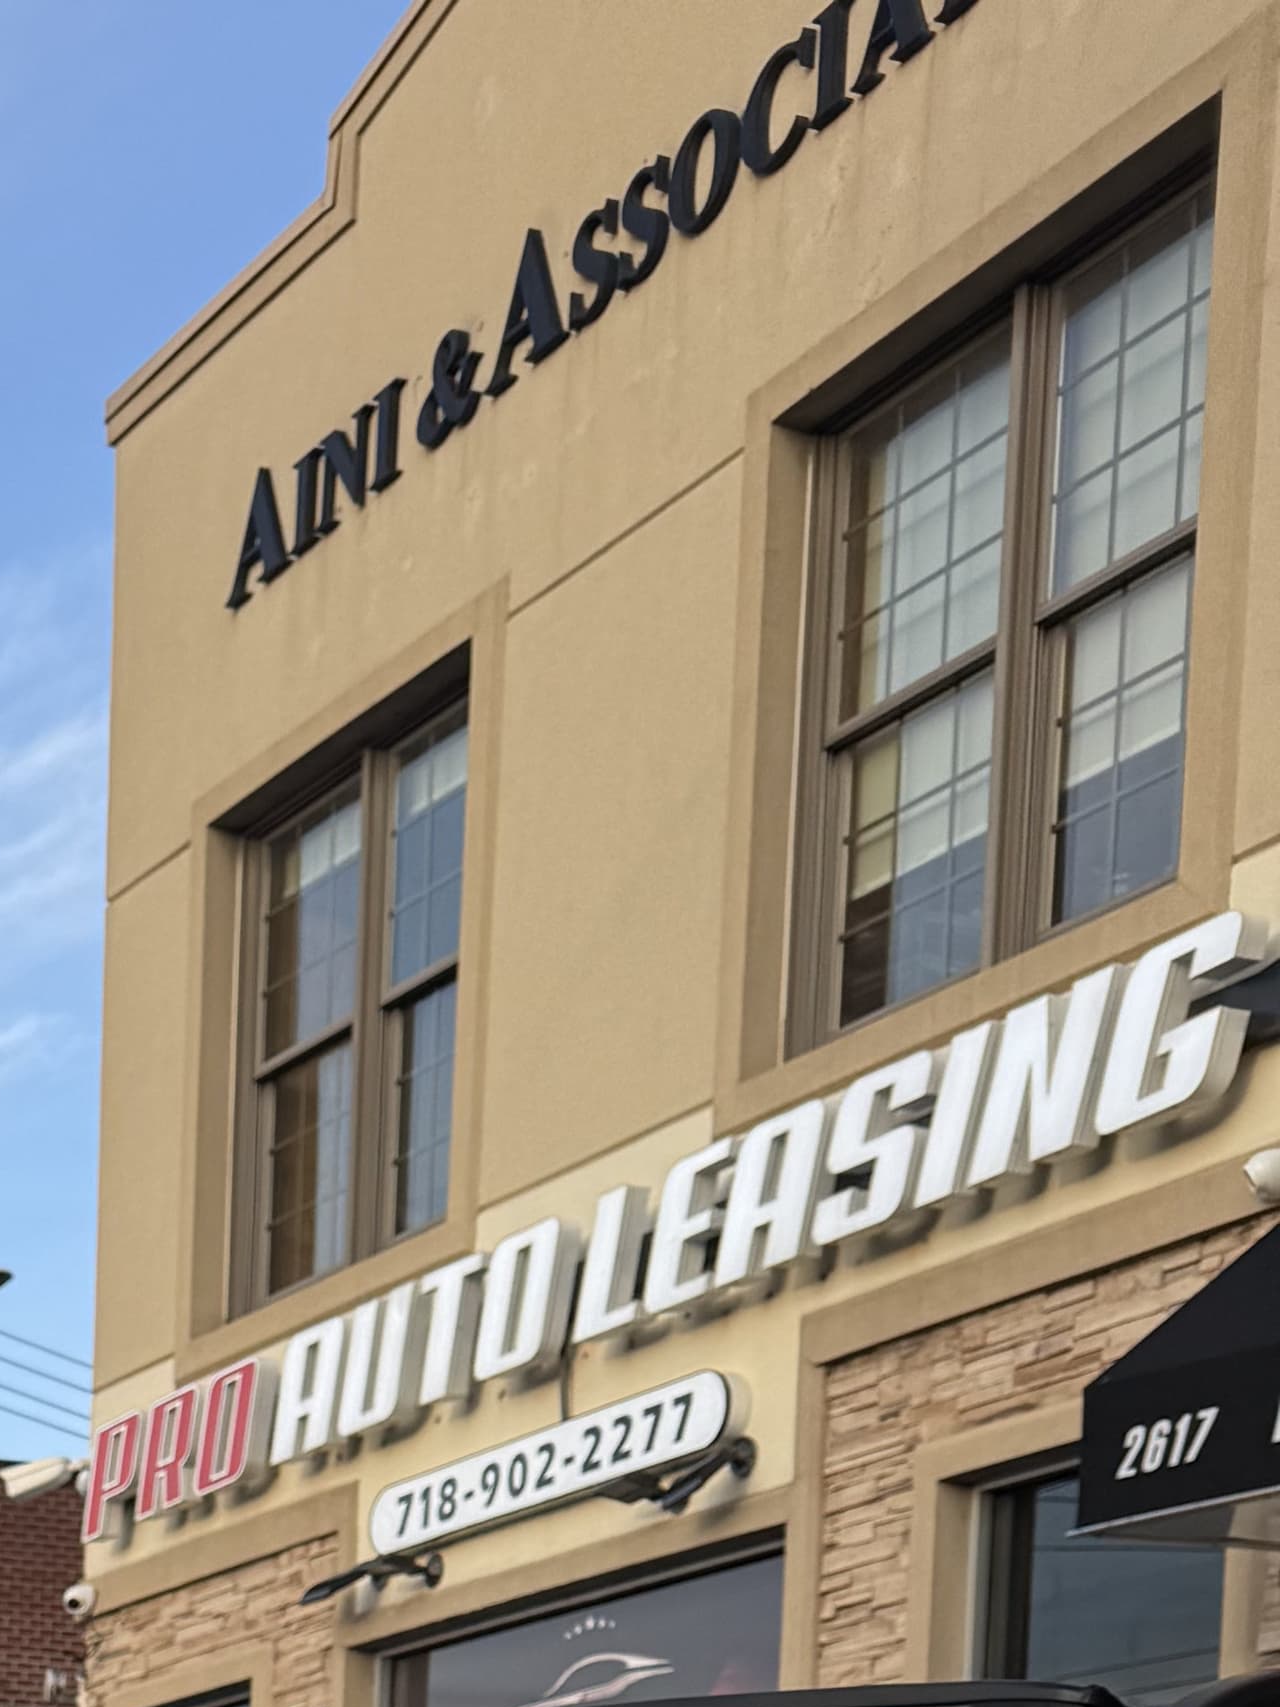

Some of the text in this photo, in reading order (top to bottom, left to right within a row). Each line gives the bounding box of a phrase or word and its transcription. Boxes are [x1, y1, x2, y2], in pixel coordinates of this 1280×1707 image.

[226, 0, 984, 610] AINI & ASSOCIA
[81, 910, 1265, 1543] PRO AUTO LEASING
[396, 1391, 696, 1538] 718-902-2277
[1114, 1405, 1220, 1480] 2617
